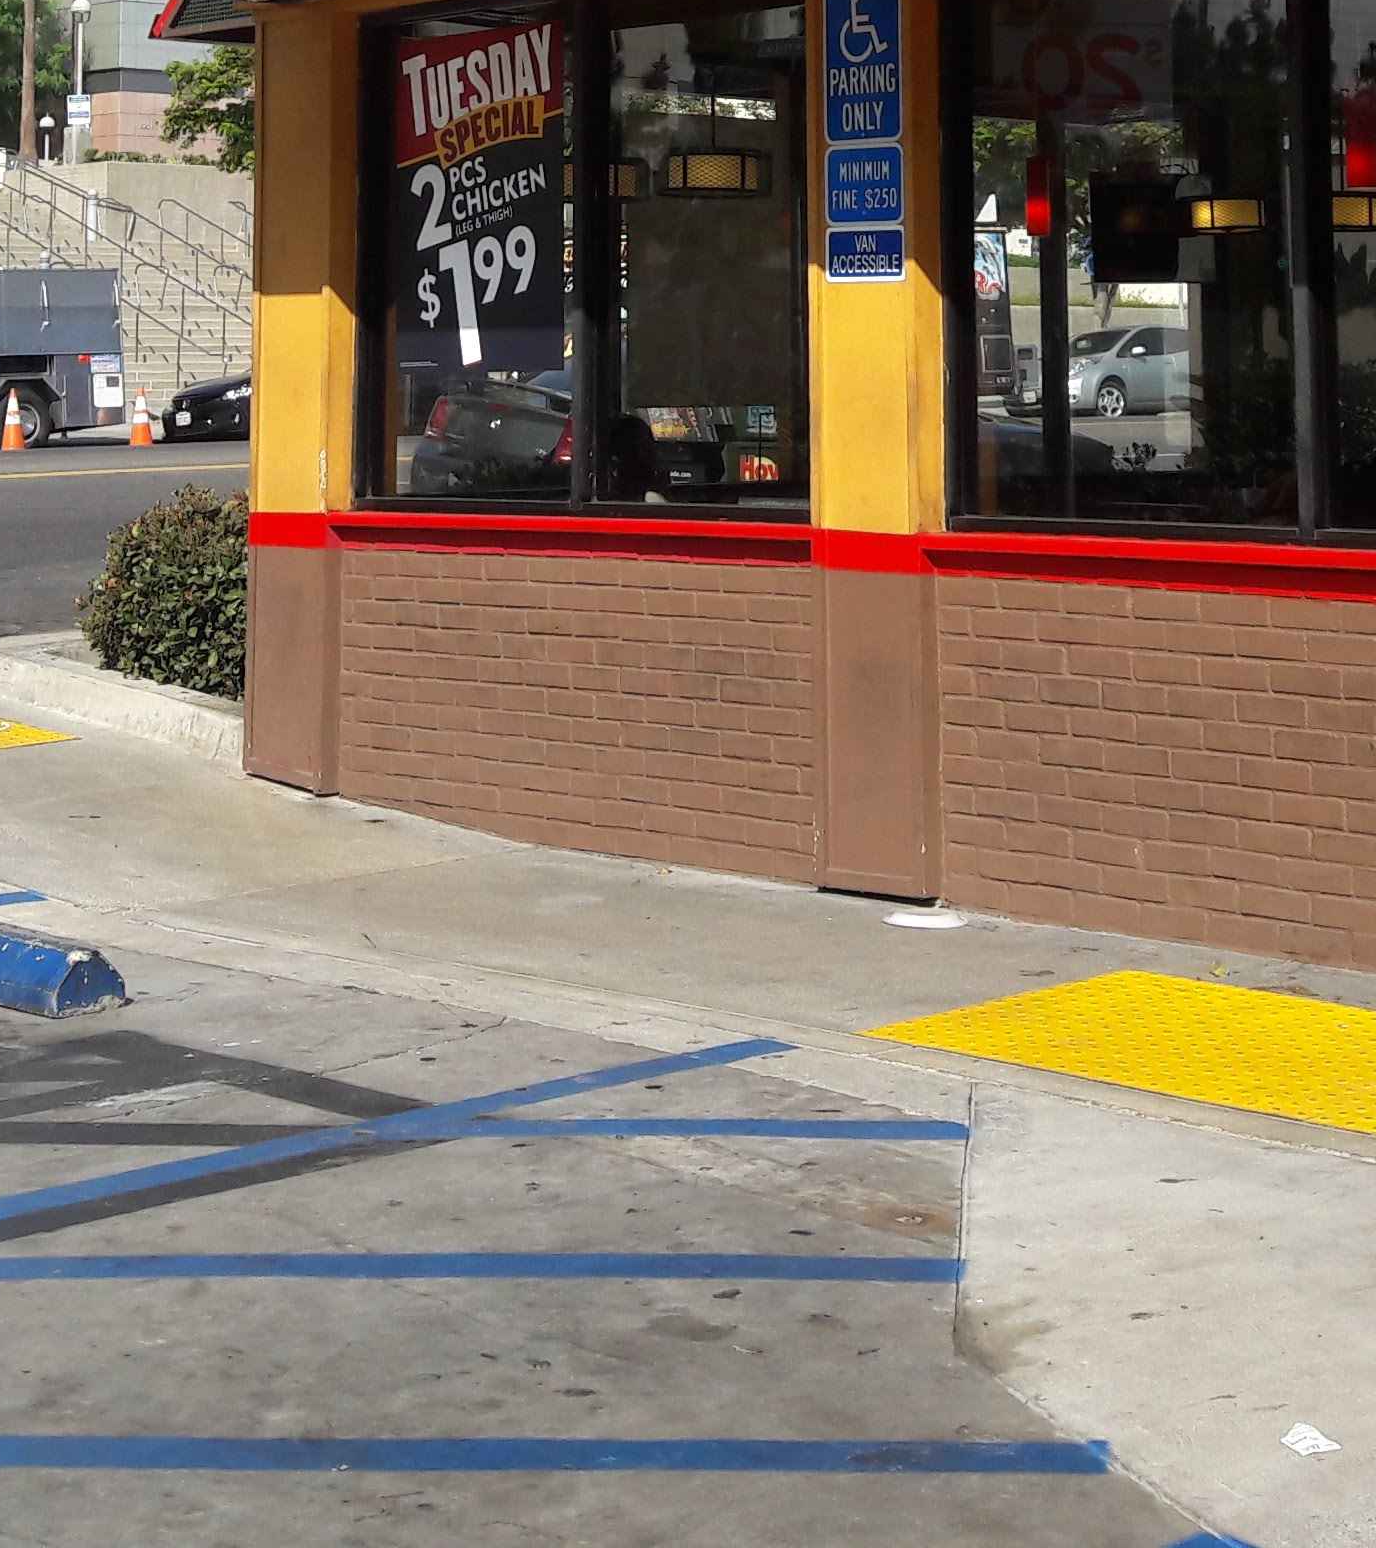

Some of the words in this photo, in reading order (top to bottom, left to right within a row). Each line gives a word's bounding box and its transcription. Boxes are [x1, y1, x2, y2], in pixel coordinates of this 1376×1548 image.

[402, 23, 552, 137] TUESDAY
[830, 63, 896, 97] PARKING
[439, 101, 539, 162] SPECIAL
[842, 101, 884, 132] ONLY
[839, 160, 890, 183] MINIMUM
[410, 163, 452, 251] 2
[449, 156, 487, 192] PCS
[451, 163, 546, 221] CHICKEN
[832, 189, 858, 210] FINE
[864, 187, 897, 209] $250
[455, 219, 474, 237] (LEG
[475, 218, 481, 229] &
[482, 205, 513, 227] THIGH)
[854, 235, 876, 252] VAN
[832, 254, 900, 274] ACCESSIBLE
